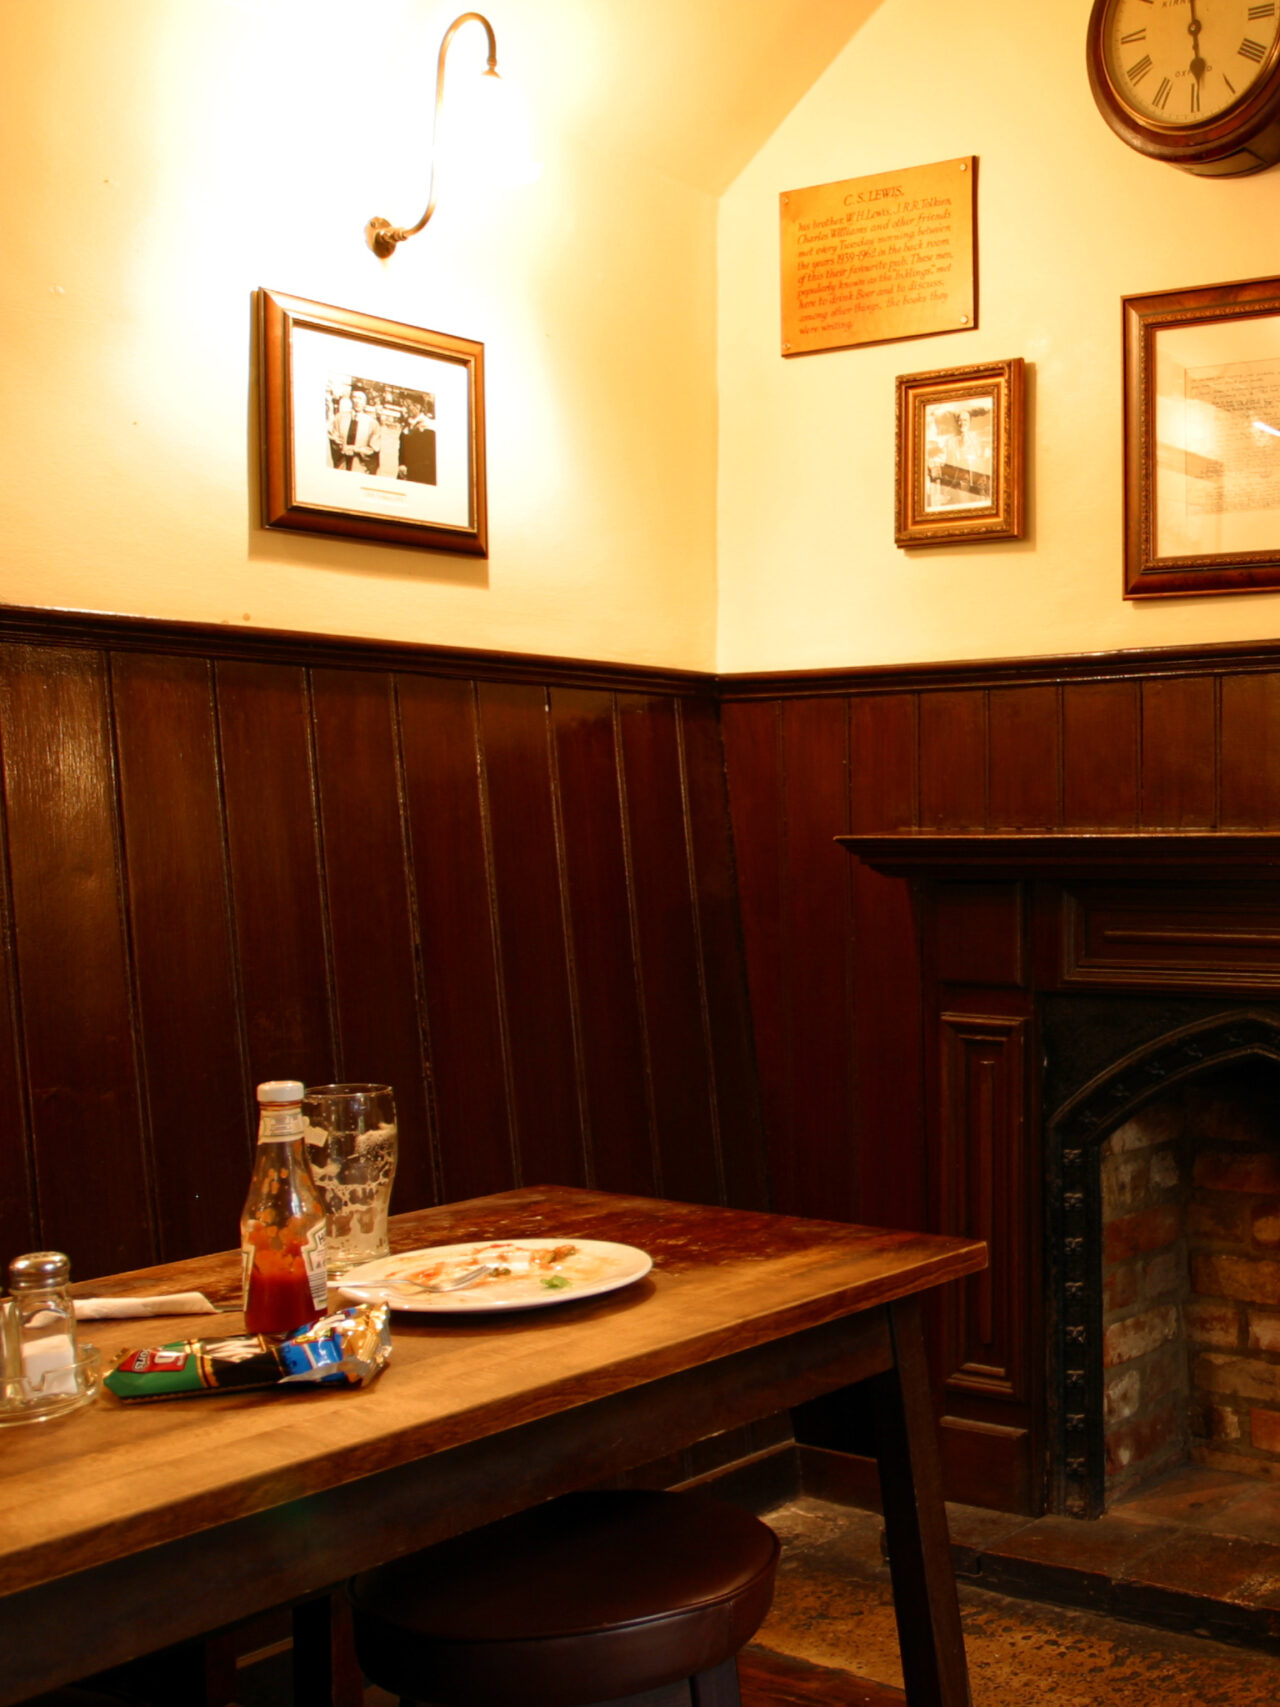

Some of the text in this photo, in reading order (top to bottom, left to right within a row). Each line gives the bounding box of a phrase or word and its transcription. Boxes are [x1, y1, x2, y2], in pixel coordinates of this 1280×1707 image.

[870, 218, 889, 232] and
[891, 215, 915, 228] other
[916, 208, 951, 225] friends
[815, 245, 838, 256] every
[917, 224, 951, 236] between
[797, 261, 810, 271] the
[811, 258, 835, 271] years
[888, 243, 901, 255] the
